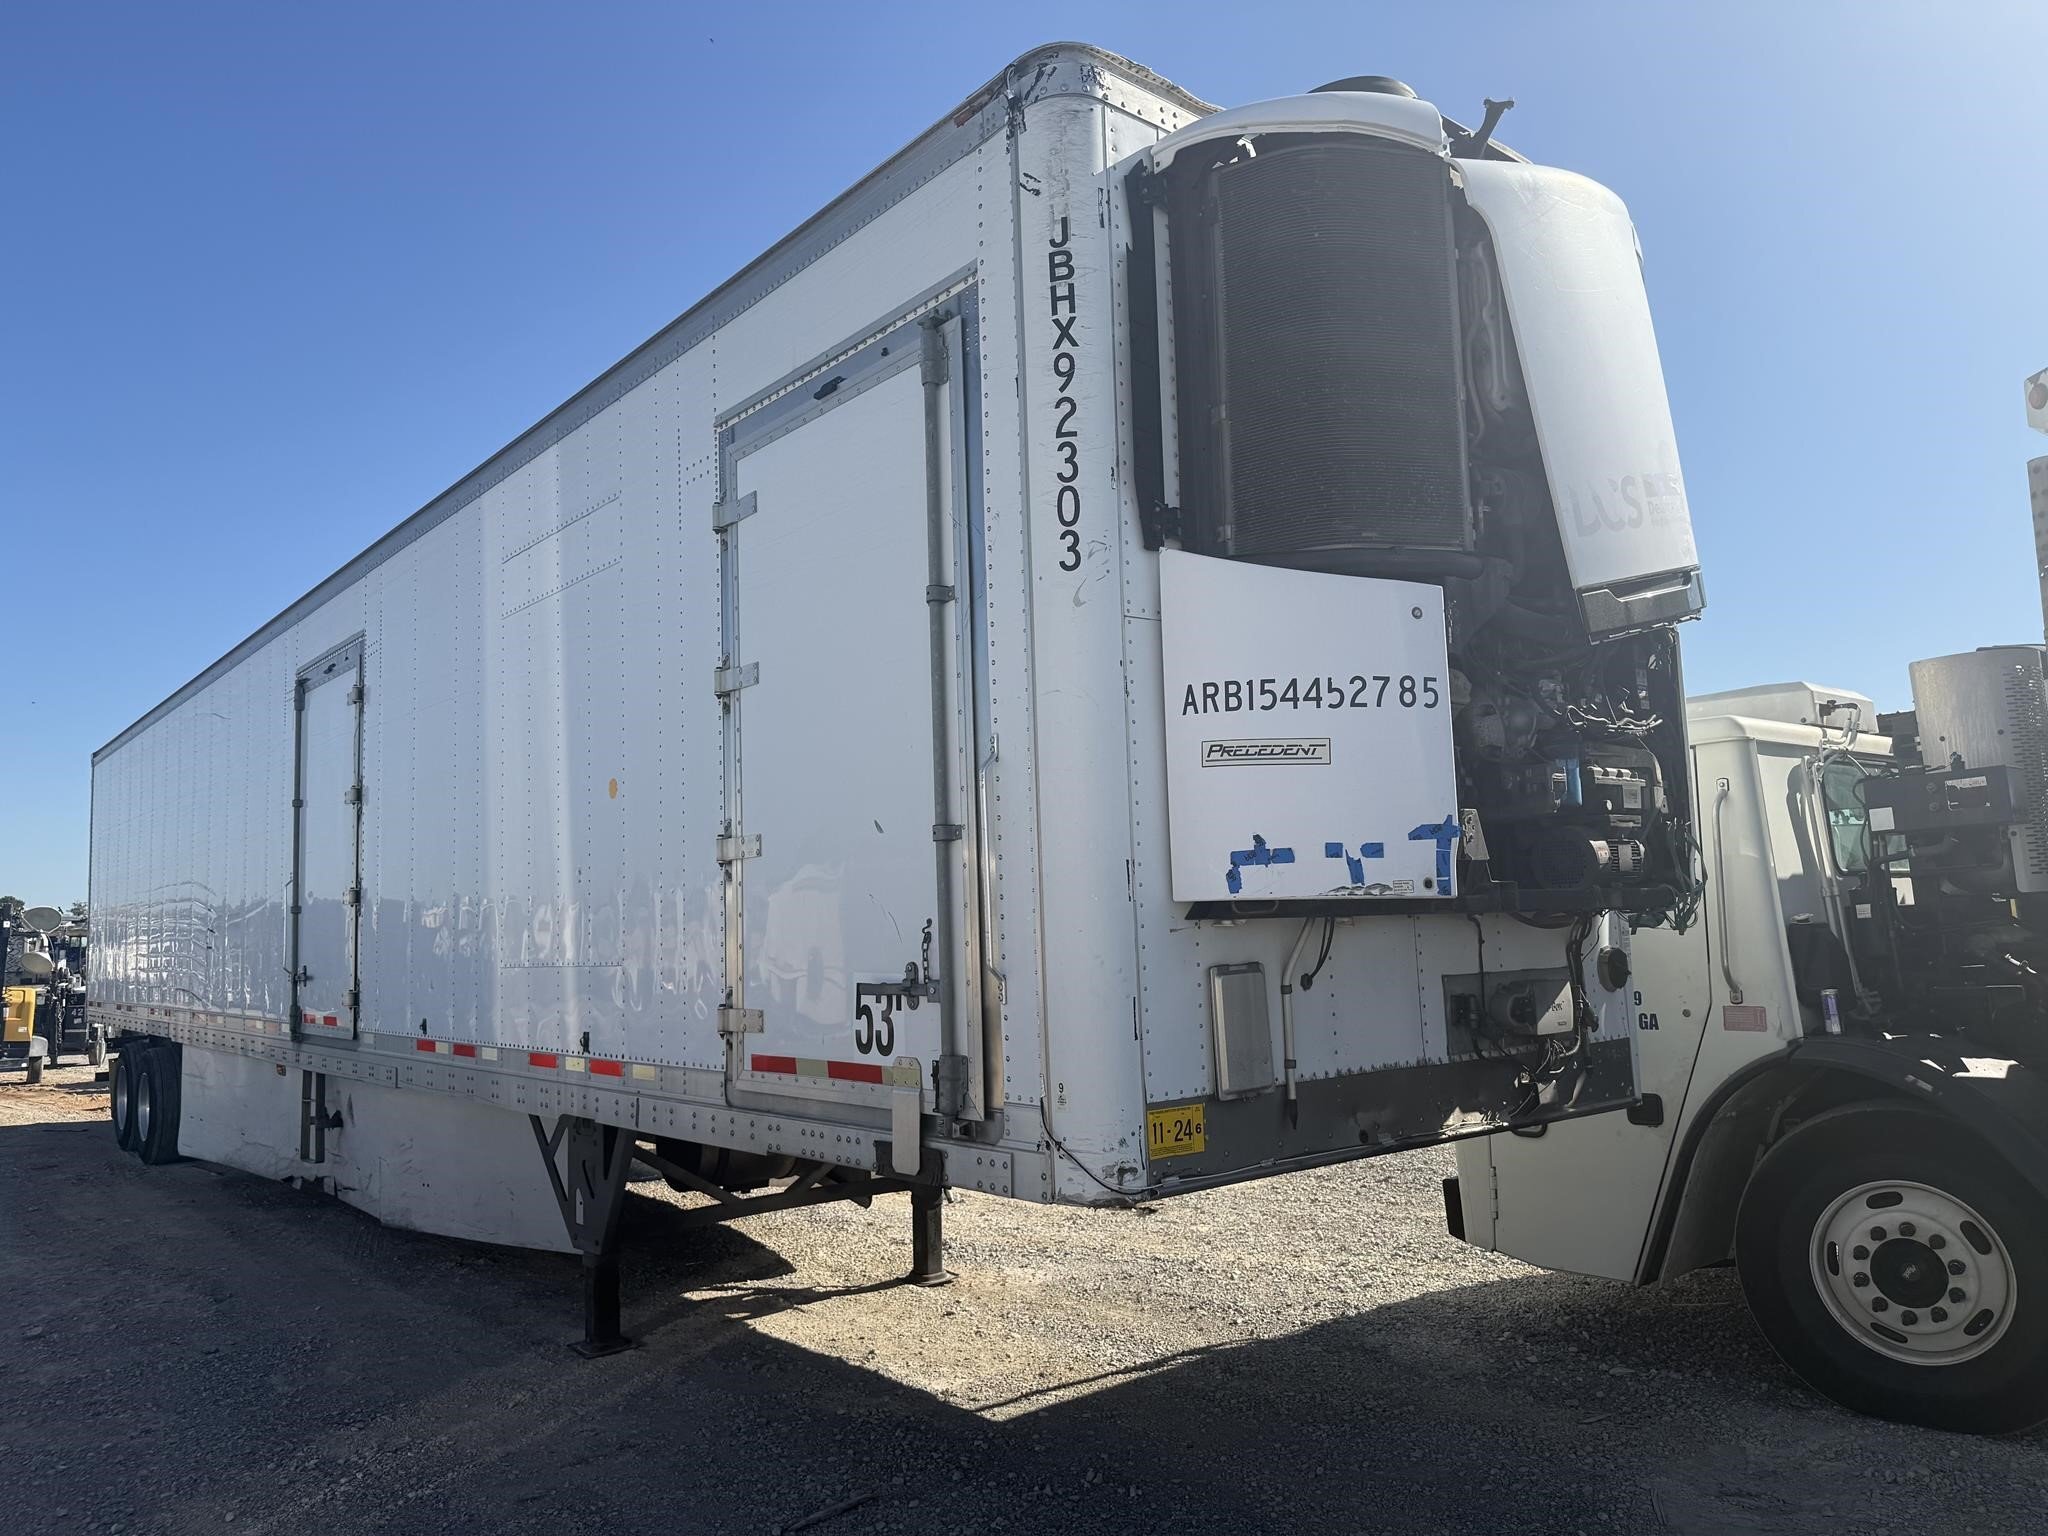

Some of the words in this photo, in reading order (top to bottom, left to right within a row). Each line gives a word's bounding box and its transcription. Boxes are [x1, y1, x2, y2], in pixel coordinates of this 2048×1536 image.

[1048, 216, 1082, 572] JBHX92303
[1633, 990, 1642, 1006] 9
[1638, 1012, 1660, 1031] GA
[1195, 1123, 1202, 1134] 6
